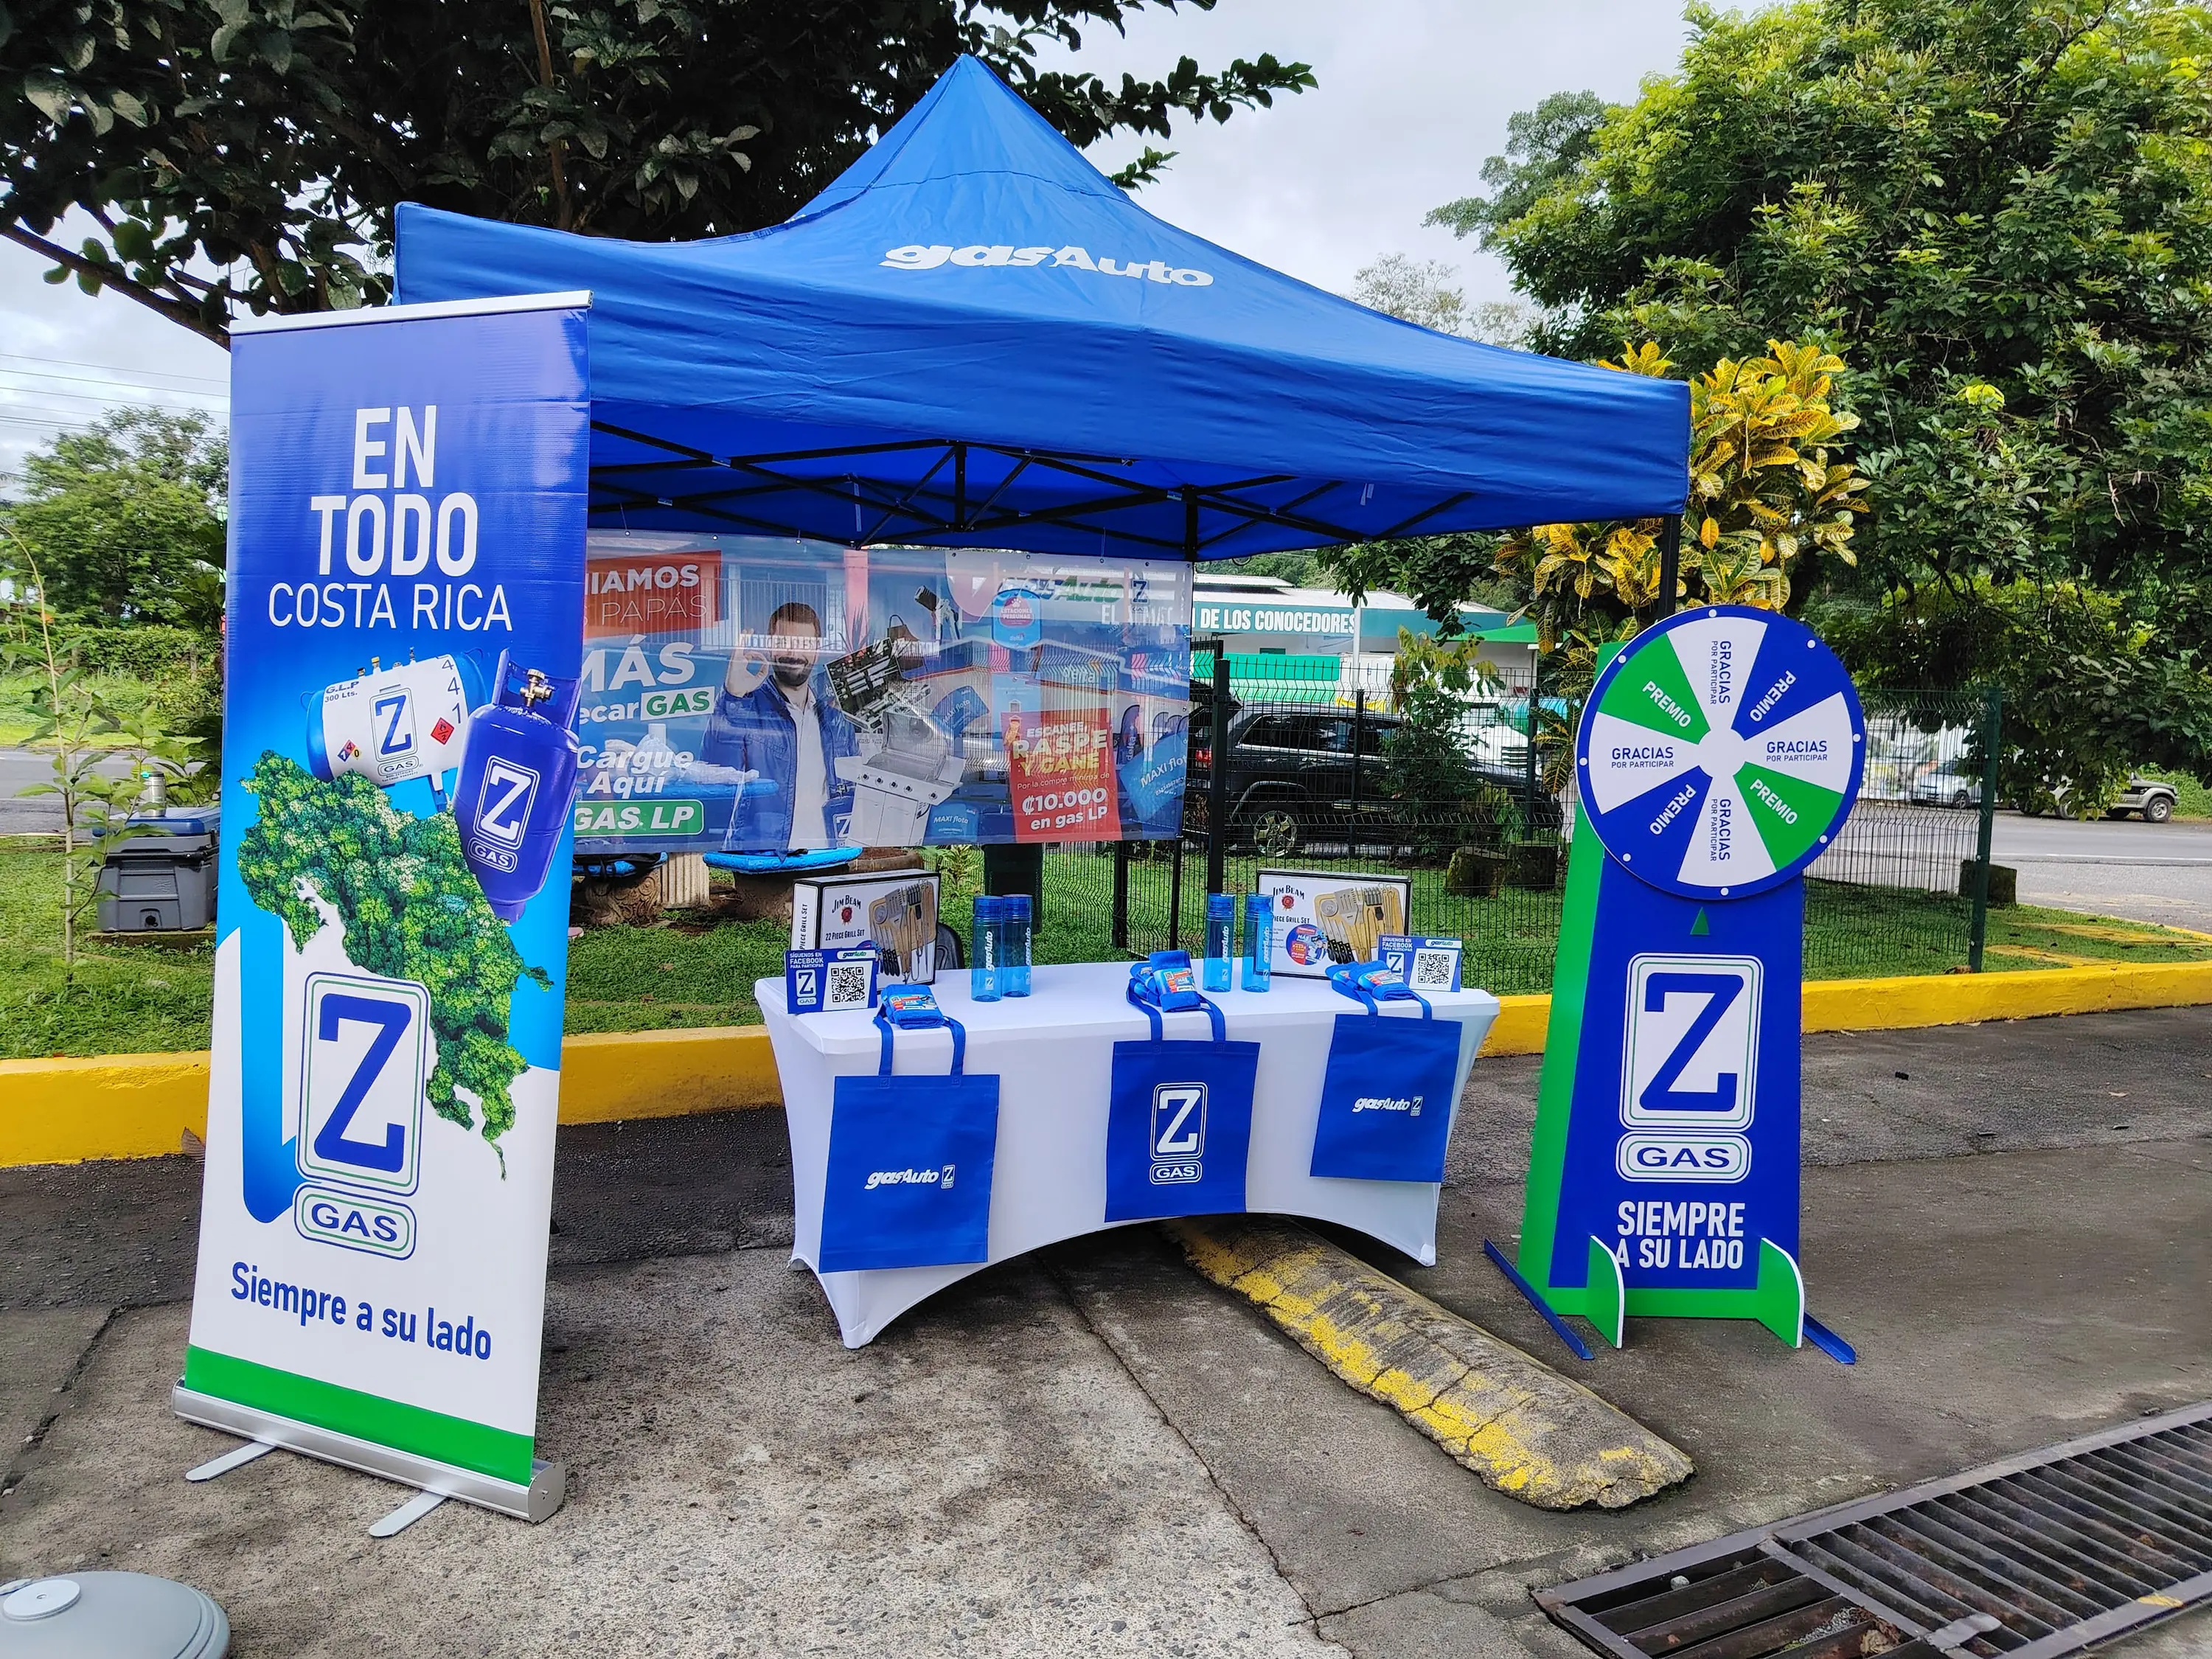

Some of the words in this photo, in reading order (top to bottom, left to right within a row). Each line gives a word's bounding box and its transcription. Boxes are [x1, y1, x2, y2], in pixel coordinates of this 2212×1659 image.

[878, 243, 1214, 286] gasAuto
[352, 405, 437, 489] EN
[310, 492, 479, 576] TODO
[585, 564, 699, 595] IAMOS
[268, 582, 396, 629] COSTA
[412, 583, 512, 631] RICA
[602, 591, 708, 626] PAPÁS
[1200, 608, 1218, 628] DE
[1224, 609, 1251, 629] LOS
[1255, 611, 1355, 633] CONOCEDORES
[442, 659, 454, 670] 4
[1719, 640, 1731, 704] GRACIAS
[448, 677, 460, 695] 4
[1709, 659, 1717, 705] PARTICIPAR
[325, 694, 339, 703] 300
[342, 691, 358, 699] Lts.
[646, 691, 710, 716] GAS
[1642, 681, 1691, 728] PREMIO
[1749, 670, 1796, 723] PREMIO
[375, 695, 411, 755] Z
[452, 703, 461, 724] 1
[1012, 729, 1107, 759] RASPE
[1611, 747, 1674, 760] GRACIAS
[1767, 740, 1828, 754] GRACIAS
[383, 760, 414, 773] GAS
[577, 745, 695, 774] Cargue
[1041, 751, 1099, 773] GANE
[1629, 760, 1674, 768] PARTICIPAR
[1784, 754, 1828, 762] PARTICIPAR
[587, 771, 667, 799] Aquí
[1017, 782, 1030, 790] Por
[1040, 777, 1068, 787] compra
[1140, 762, 1168, 788] MAXI
[481, 765, 531, 841] Z
[1649, 784, 1696, 835] PREMIO
[1749, 779, 1798, 826] PREMIO
[574, 807, 641, 831] GAS
[650, 806, 695, 829] LP
[933, 816, 953, 824] MAXI
[953, 816, 969, 824] flota
[1031, 818, 1050, 830] en
[1055, 812, 1084, 828] gas
[1088, 806, 1107, 821] LP
[1719, 799, 1731, 861] GRACIAS
[1709, 817, 1717, 862] PARTICIPAR
[473, 844, 510, 866] GAS
[832, 898, 844, 914] JIM
[845, 894, 861, 910] BEAM
[1273, 887, 1284, 896] JIM
[1285, 885, 1304, 900] BEAM
[825, 932, 831, 941] 22
[832, 931, 844, 940] PIECE
[844, 929, 857, 938] GRILL
[857, 929, 865, 937] SET
[984, 931, 995, 972] gasAuto
[1389, 954, 1402, 973] Z
[799, 972, 813, 995] Z
[1639, 973, 1744, 1110] Z
[314, 993, 412, 1173] Z
[1352, 1097, 1411, 1113] gasAuto
[1412, 1098, 1422, 1110] Z
[1157, 1090, 1201, 1153] Z
[1636, 1147, 1730, 1168] GAS
[864, 1169, 939, 1189] gasAuto
[944, 1166, 953, 1182] Z
[1156, 1166, 1195, 1178] GAS
[310, 1203, 398, 1242] GAS
[1618, 1201, 1745, 1237] SIEMPRE
[1615, 1238, 1630, 1268] A
[1638, 1238, 1670, 1269] SU
[1678, 1239, 1744, 1269] LADO
[232, 1262, 346, 1326] Siempre
[357, 1302, 373, 1332] a
[382, 1308, 416, 1343] su
[426, 1308, 492, 1361] lado
